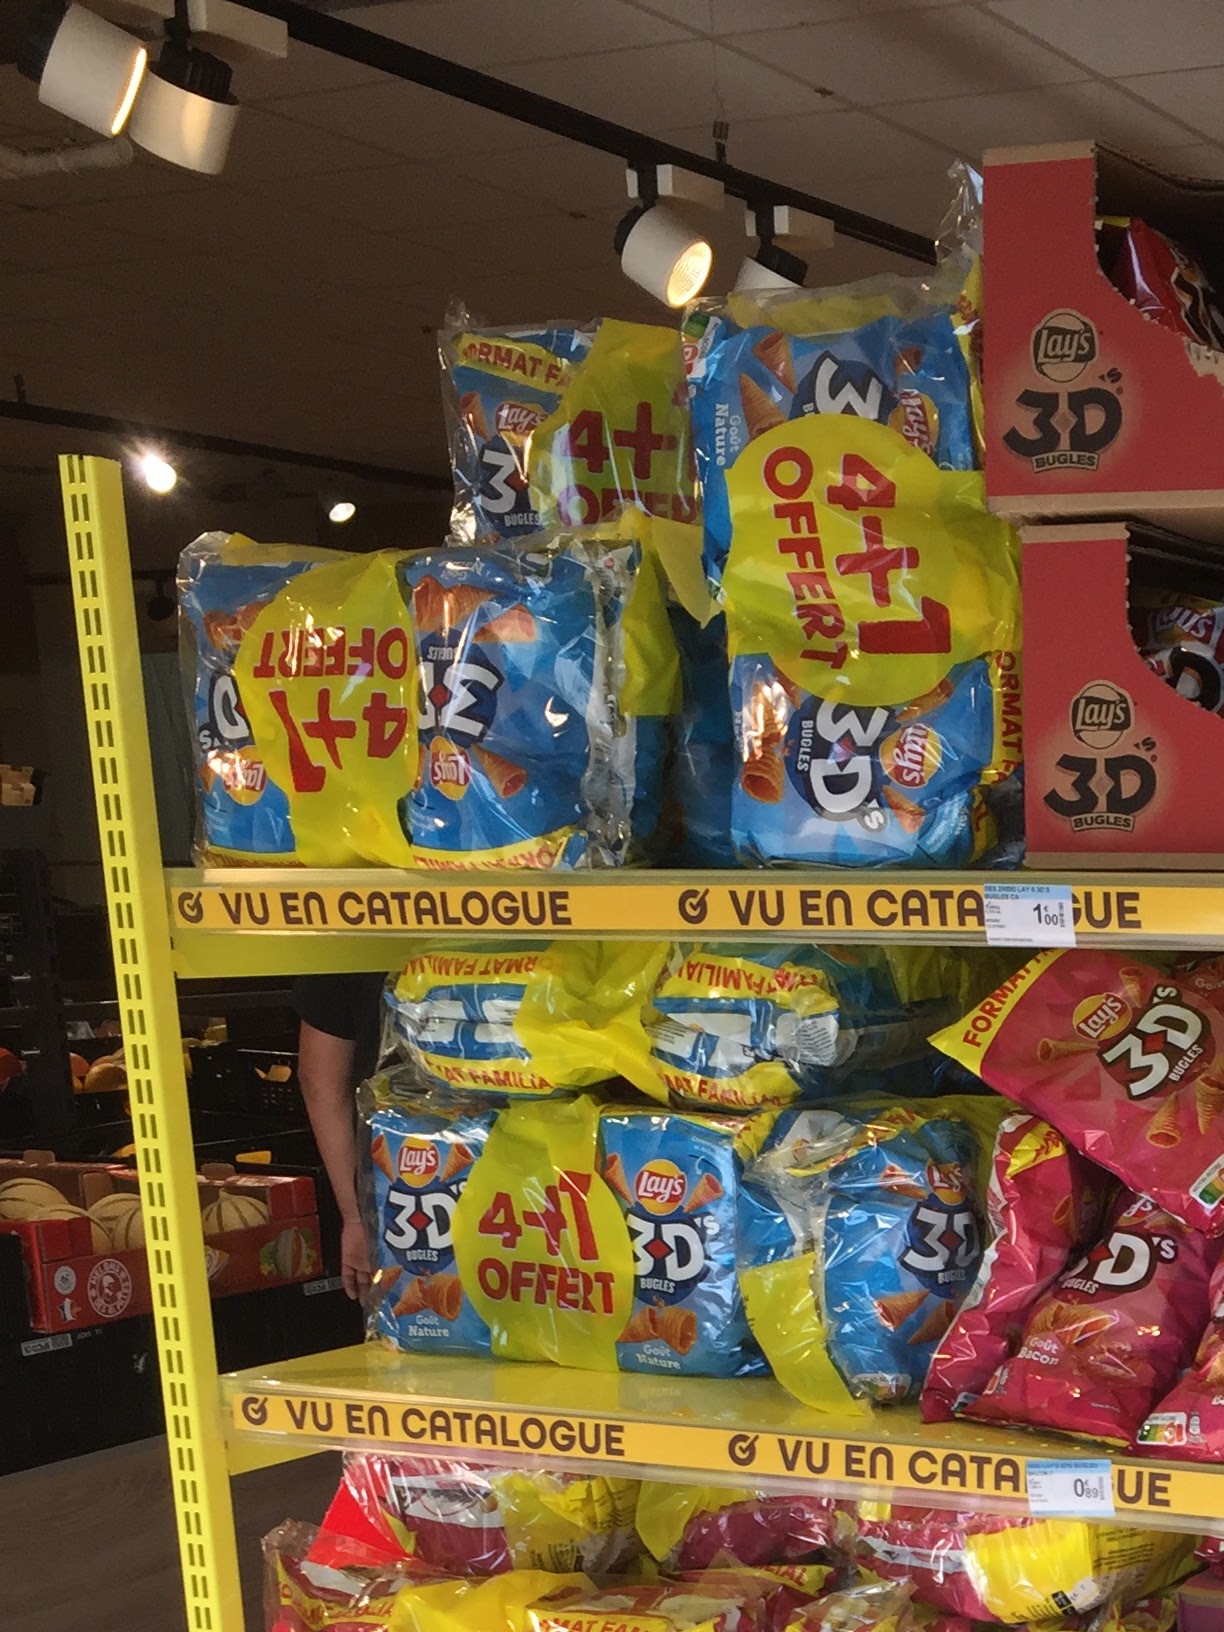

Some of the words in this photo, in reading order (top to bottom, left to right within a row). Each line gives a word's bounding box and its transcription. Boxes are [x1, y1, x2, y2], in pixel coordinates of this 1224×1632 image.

[1037, 329, 1092, 365] Lay's
[716, 403, 729, 466] Nature
[1034, 451, 1097, 469] BUGLES
[505, 513, 541, 527] BUGLES
[763, 446, 848, 670] OFFERT
[827, 454, 951, 653] 4+1
[253, 628, 408, 679] OFFERT
[1074, 700, 1130, 730] Lay's
[269, 688, 407, 793] 4+1
[797, 720, 814, 772] BUGLES
[1073, 816, 1133, 830] BUGLES
[219, 893, 274, 926] VU
[283, 893, 329, 925] EN
[336, 891, 573, 927] CATALOGUE
[729, 891, 785, 925] VU
[799, 892, 851, 927] EN
[867, 891, 1141, 930] CATAUE
[1078, 996, 1124, 1038] Lay's
[1168, 1045, 1204, 1084] BUGLES
[399, 1146, 438, 1174] Lay's
[637, 1174, 686, 1200] Lay's
[478, 1171, 599, 1260] 4+1
[405, 1250, 438, 1262] BUGLES
[478, 1259, 615, 1313] OFFERT
[640, 1278, 675, 1293] BUGLES
[408, 1325, 450, 1339] Nature
[285, 1401, 334, 1431] VU
[348, 1405, 388, 1436] EN
[402, 1410, 625, 1455] CATALOGUE
[777, 1438, 830, 1473] VU
[844, 1441, 892, 1479] EN
[908, 1452, 1171, 1506] CATAUE
